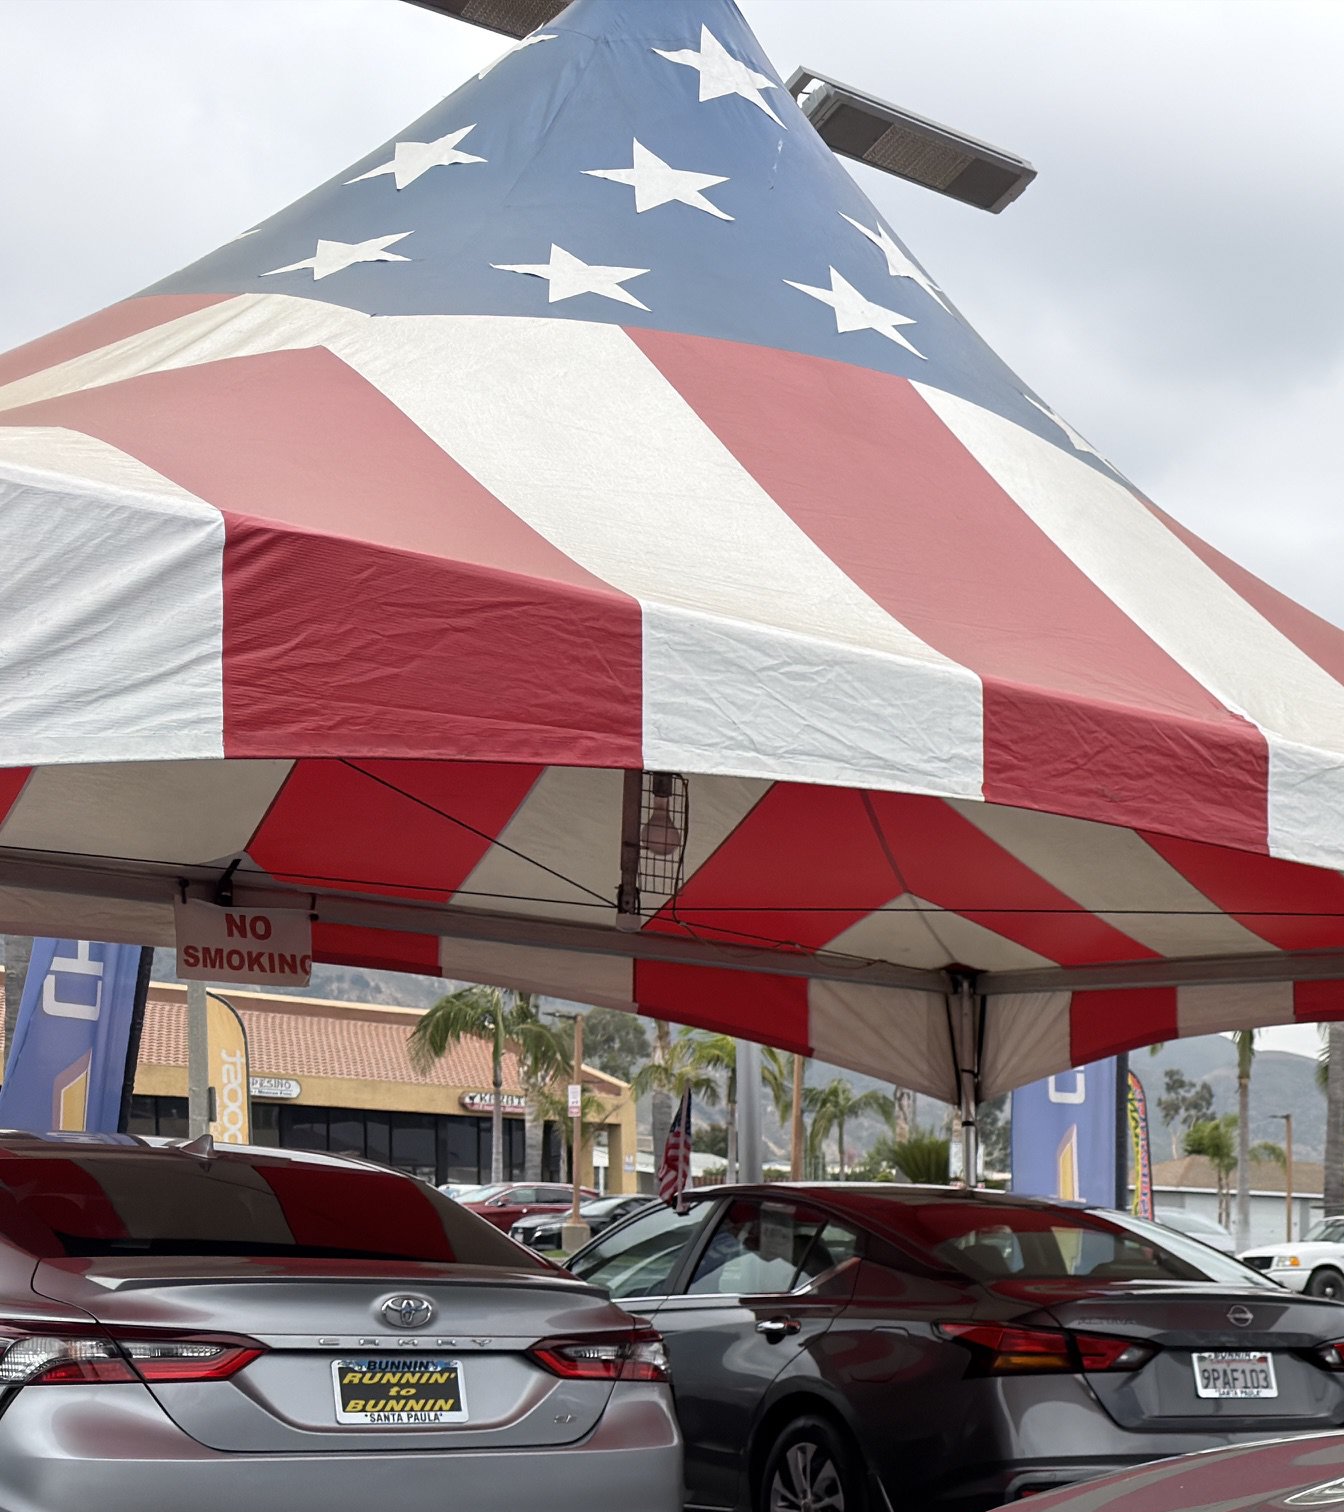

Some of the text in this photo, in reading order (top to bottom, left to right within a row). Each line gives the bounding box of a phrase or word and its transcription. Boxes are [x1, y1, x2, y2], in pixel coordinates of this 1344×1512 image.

[225, 913, 272, 940] NO
[342, 1372, 456, 1384] RUNNIN'
[1202, 1368, 1270, 1390] 9PAF103
[388, 1386, 417, 1396] to
[345, 1399, 454, 1412] BUNNIN
